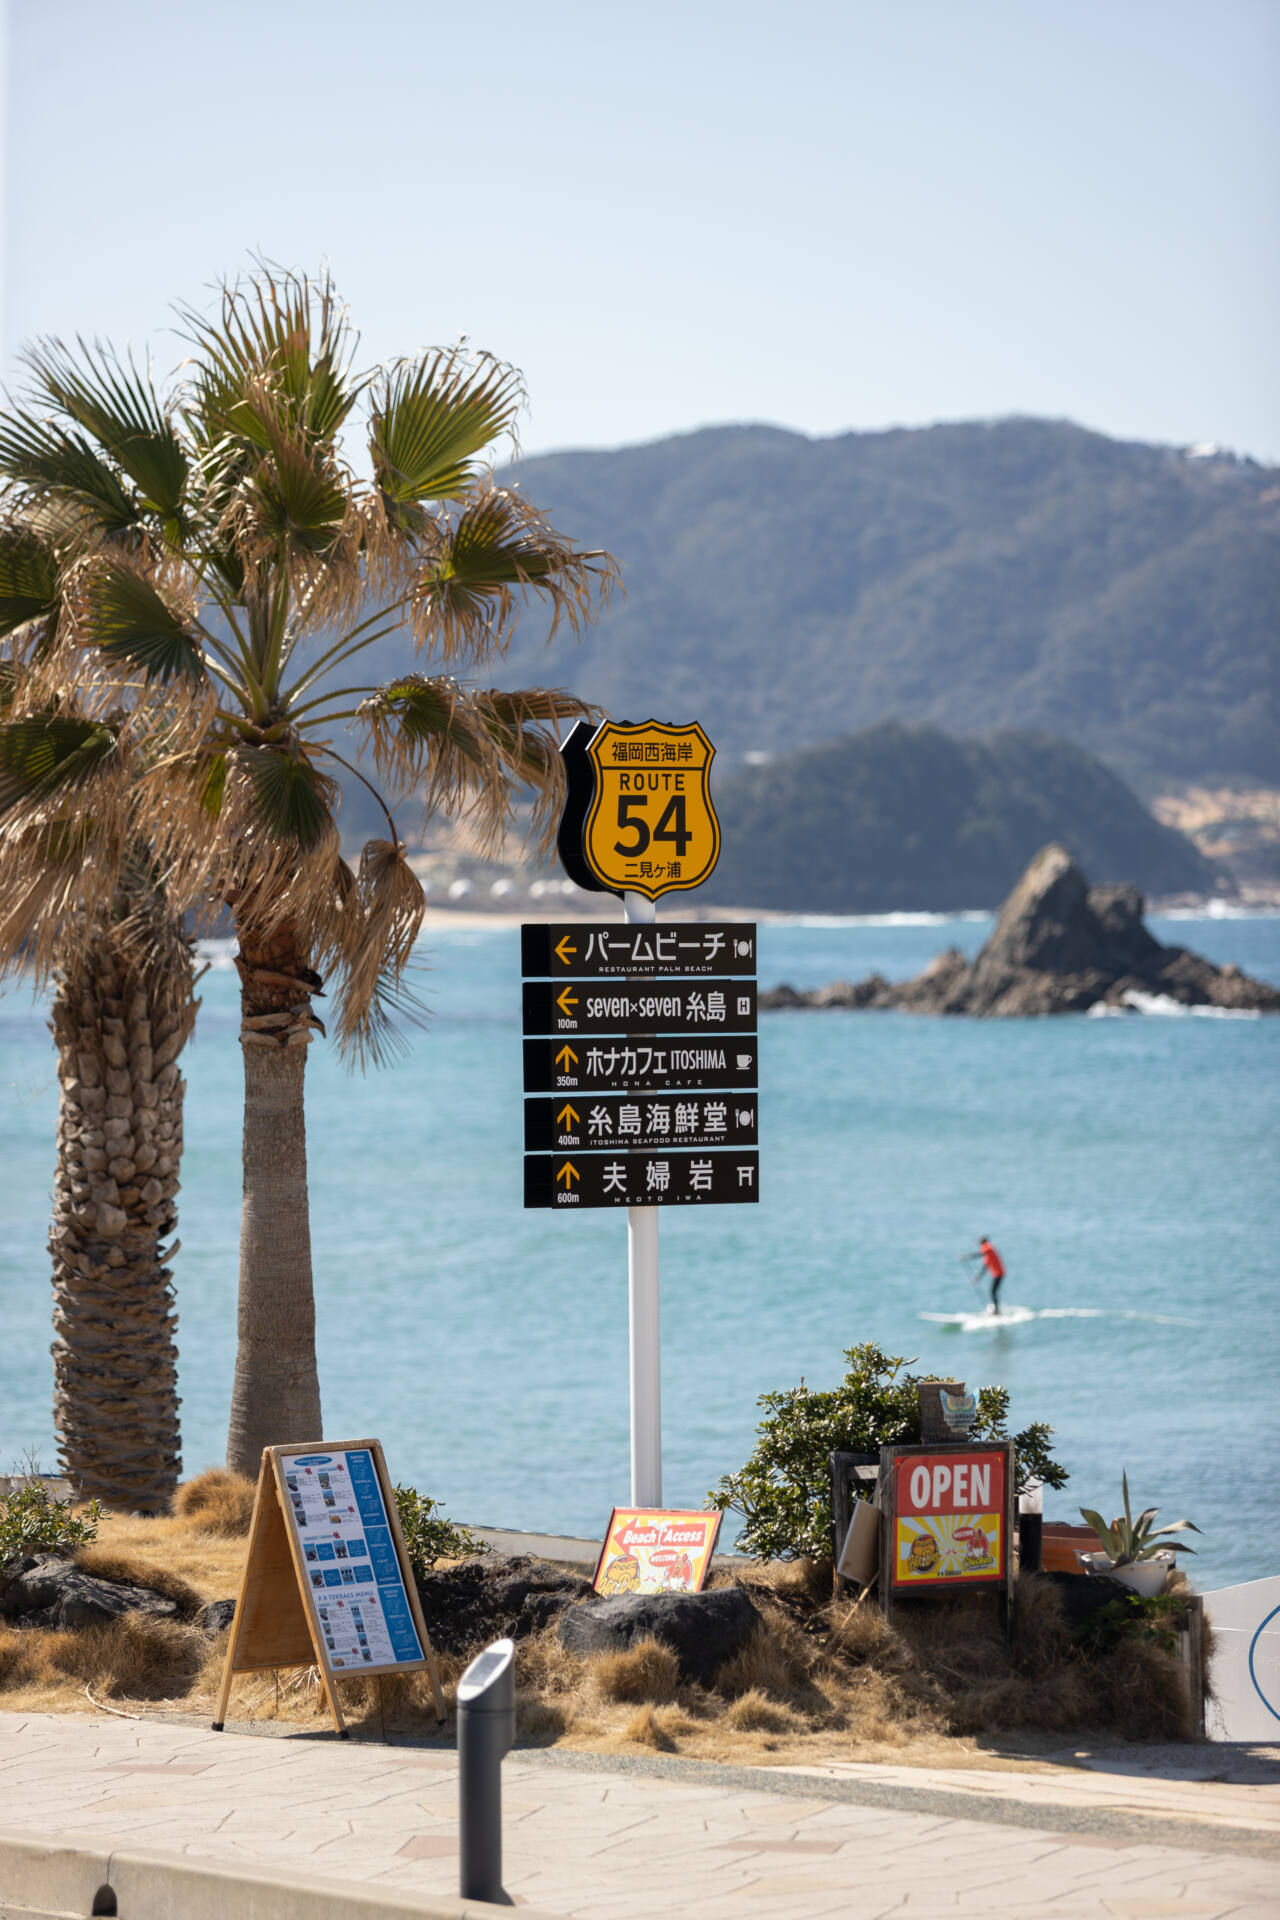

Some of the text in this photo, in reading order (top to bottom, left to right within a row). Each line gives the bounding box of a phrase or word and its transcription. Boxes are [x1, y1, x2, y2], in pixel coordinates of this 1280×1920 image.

[611, 741, 693, 762] 福岡西海岸
[619, 773, 685, 791] ROUTE
[613, 795, 693, 858] 54
[584, 931, 726, 962] パームビーチ
[686, 990, 727, 1023] 糸島
[557, 1018, 578, 1029] 100m
[586, 1047, 727, 1077] ホナカフェ ITOSHIMA
[556, 1075, 579, 1087] 350m
[587, 1101, 728, 1137] 糸島海鮮堂
[557, 1134, 580, 1146] 400m
[590, 1135, 726, 1146] ITOSHIMA SEAFOOD RESTAURANT
[602, 1159, 714, 1193] 夫婦岩
[557, 1192, 580, 1203] 600m
[614, 1195, 664, 1203] MEOTO
[910, 1464, 991, 1509] OPEN
[622, 1528, 703, 1544] Beach Access
[650, 1553, 679, 1563] WELCOME
[354, 1590, 375, 1599] MENU
